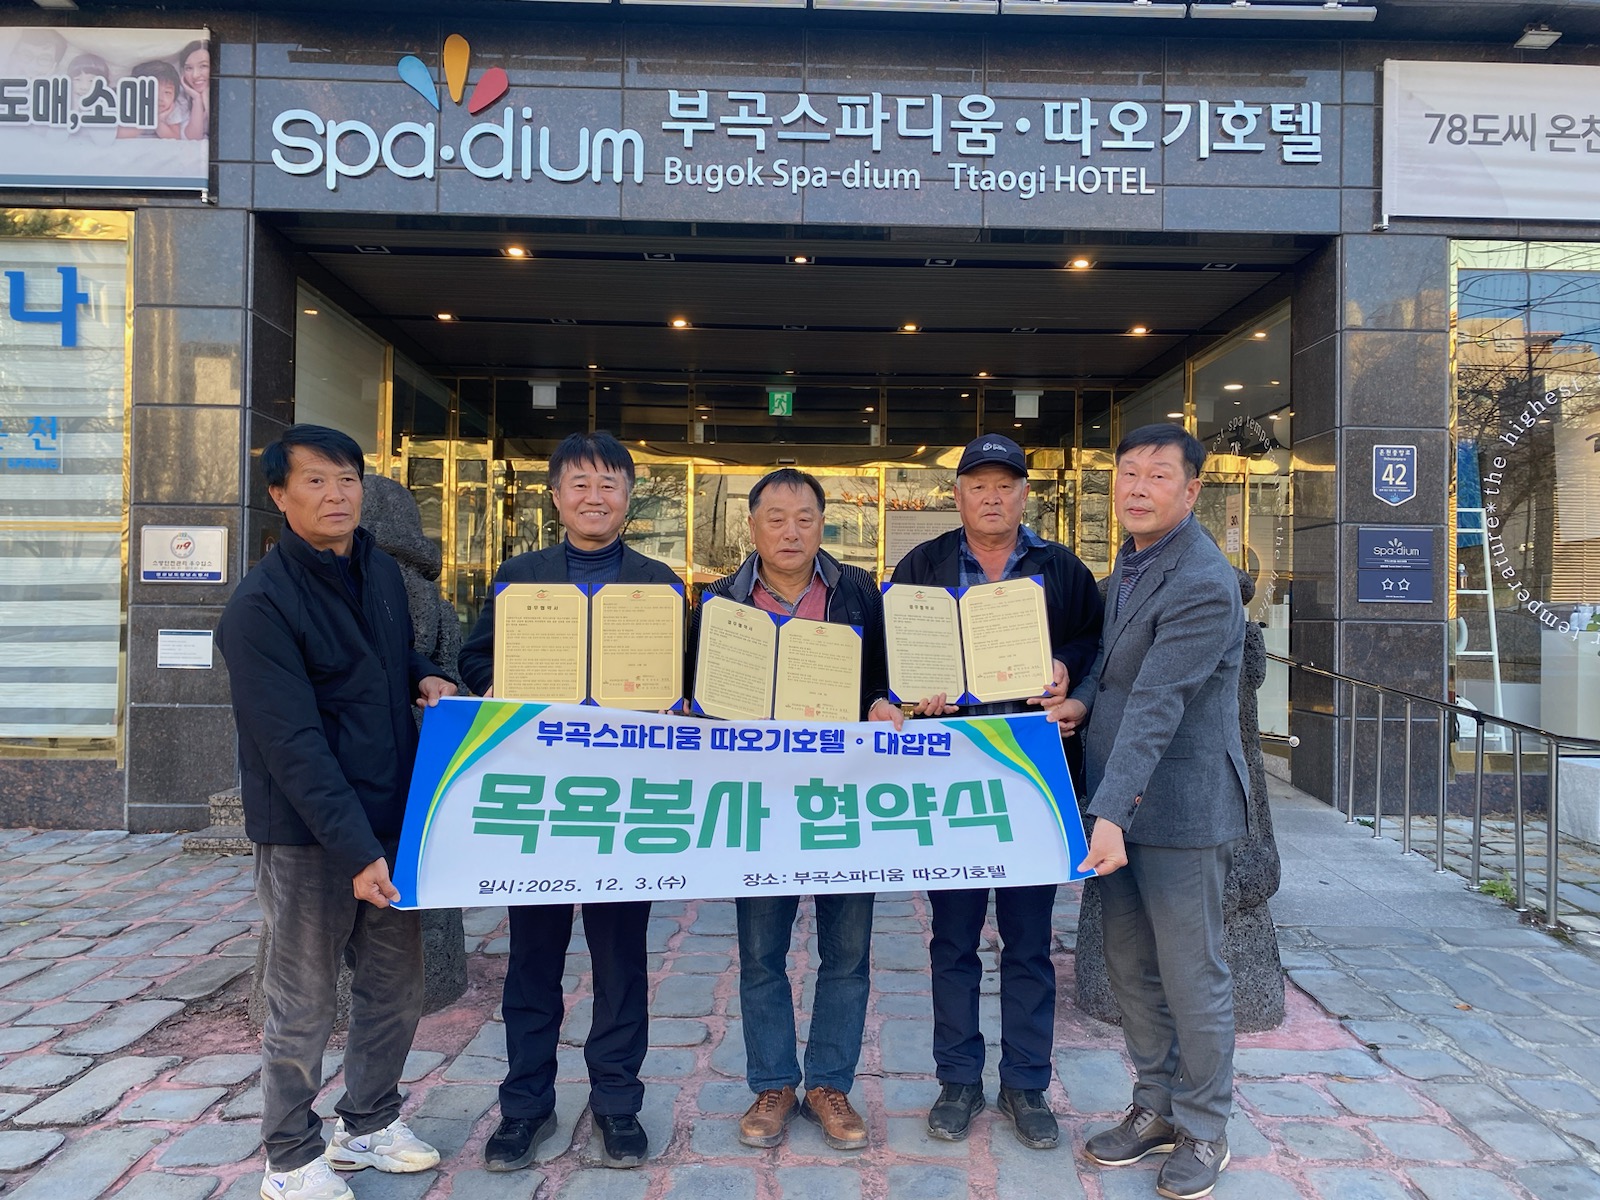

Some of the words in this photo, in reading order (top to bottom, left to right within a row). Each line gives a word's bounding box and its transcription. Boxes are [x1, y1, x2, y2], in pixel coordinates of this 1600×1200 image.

[0, 77, 156, 130] 도매,소매
[1424, 112, 1537, 152] 78도씨
[663, 156, 765, 193] Bugok
[772, 158, 921, 194] Spa-dium
[947, 161, 1046, 200] Ttaogi
[1053, 164, 1156, 196] HOTEL
[1499, 378, 1582, 447] highest
[0, 415, 57, 451] 천
[1381, 463, 1408, 486] 42
[1483, 456, 1507, 496] the
[1486, 515, 1580, 642] temperature
[536, 720, 702, 751] 부곡스파디움
[710, 727, 846, 754] 따오기호텔
[873, 730, 952, 757] 대합면
[471, 773, 771, 855] 목욕봉사
[793, 777, 1014, 851] 협약식
[595, 878, 624, 891] 12.
[742, 873, 788, 887] 장소:
[793, 867, 905, 886] 부곡스파디움
[912, 864, 1007, 882] 따오기호텔
